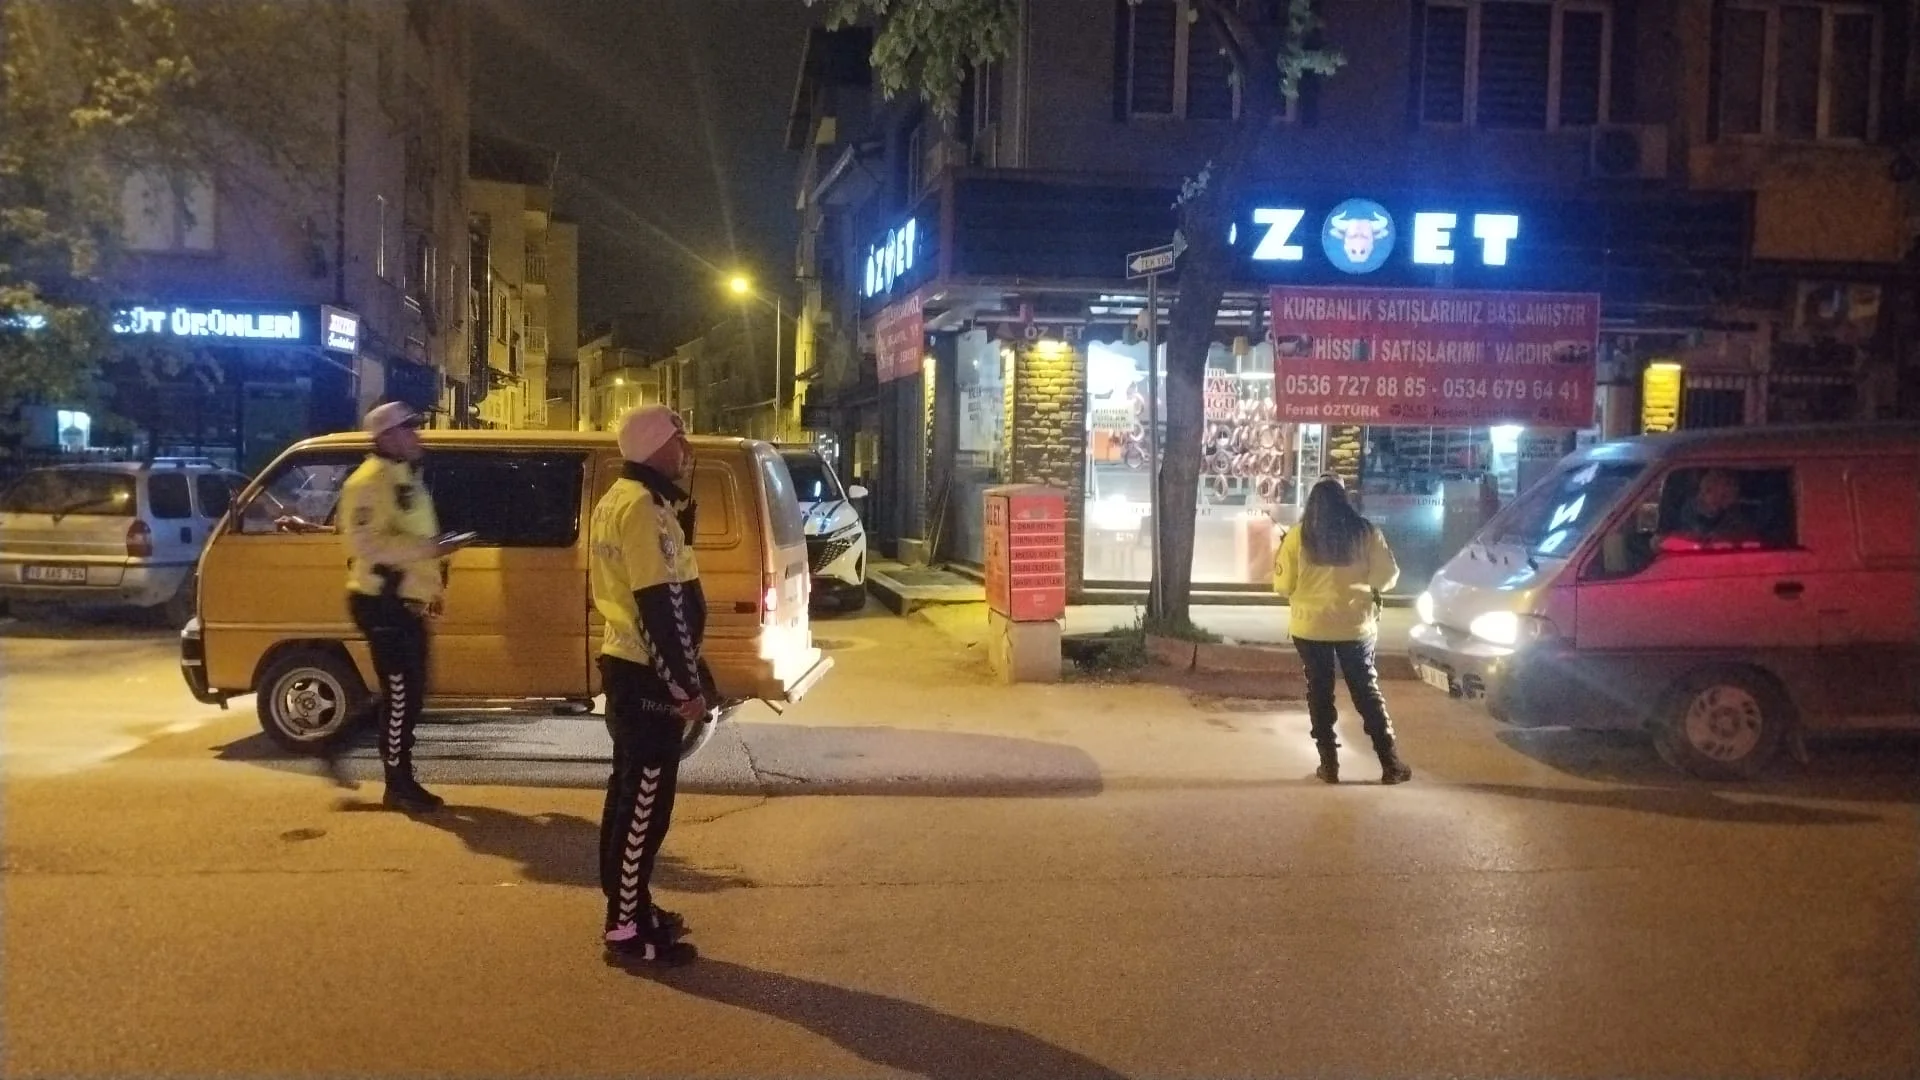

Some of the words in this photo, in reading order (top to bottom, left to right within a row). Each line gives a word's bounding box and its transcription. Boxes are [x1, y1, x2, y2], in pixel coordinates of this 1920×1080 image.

[1228, 207, 1305, 261] Z
[1413, 212, 1519, 266] ET
[865, 244, 885, 298] ÖZ
[896, 218, 916, 277] ET
[172, 307, 300, 339] ÜRÜNLERİ
[1283, 297, 1373, 321] KURBANLIK
[1378, 299, 1483, 328] SATIŞLARIMIZ
[1024, 323, 1049, 340] ÖZ
[1063, 325, 1086, 341] ET
[1315, 334, 1376, 362] HİSSİ
[1382, 339, 1491, 368] SATIŞLARIMI
[1496, 343, 1552, 365] VARDIR
[1285, 374, 1331, 396] 0536
[1337, 375, 1371, 397] 727
[1376, 376, 1399, 398] 88
[1404, 376, 1426, 398] 85
[1443, 377, 1488, 399] 0534
[1493, 379, 1527, 400] 679
[1532, 380, 1553, 400] 64
[1559, 381, 1579, 401] 41
[1285, 403, 1319, 416] Ferat
[1323, 402, 1380, 418] ÖZTÜRK
